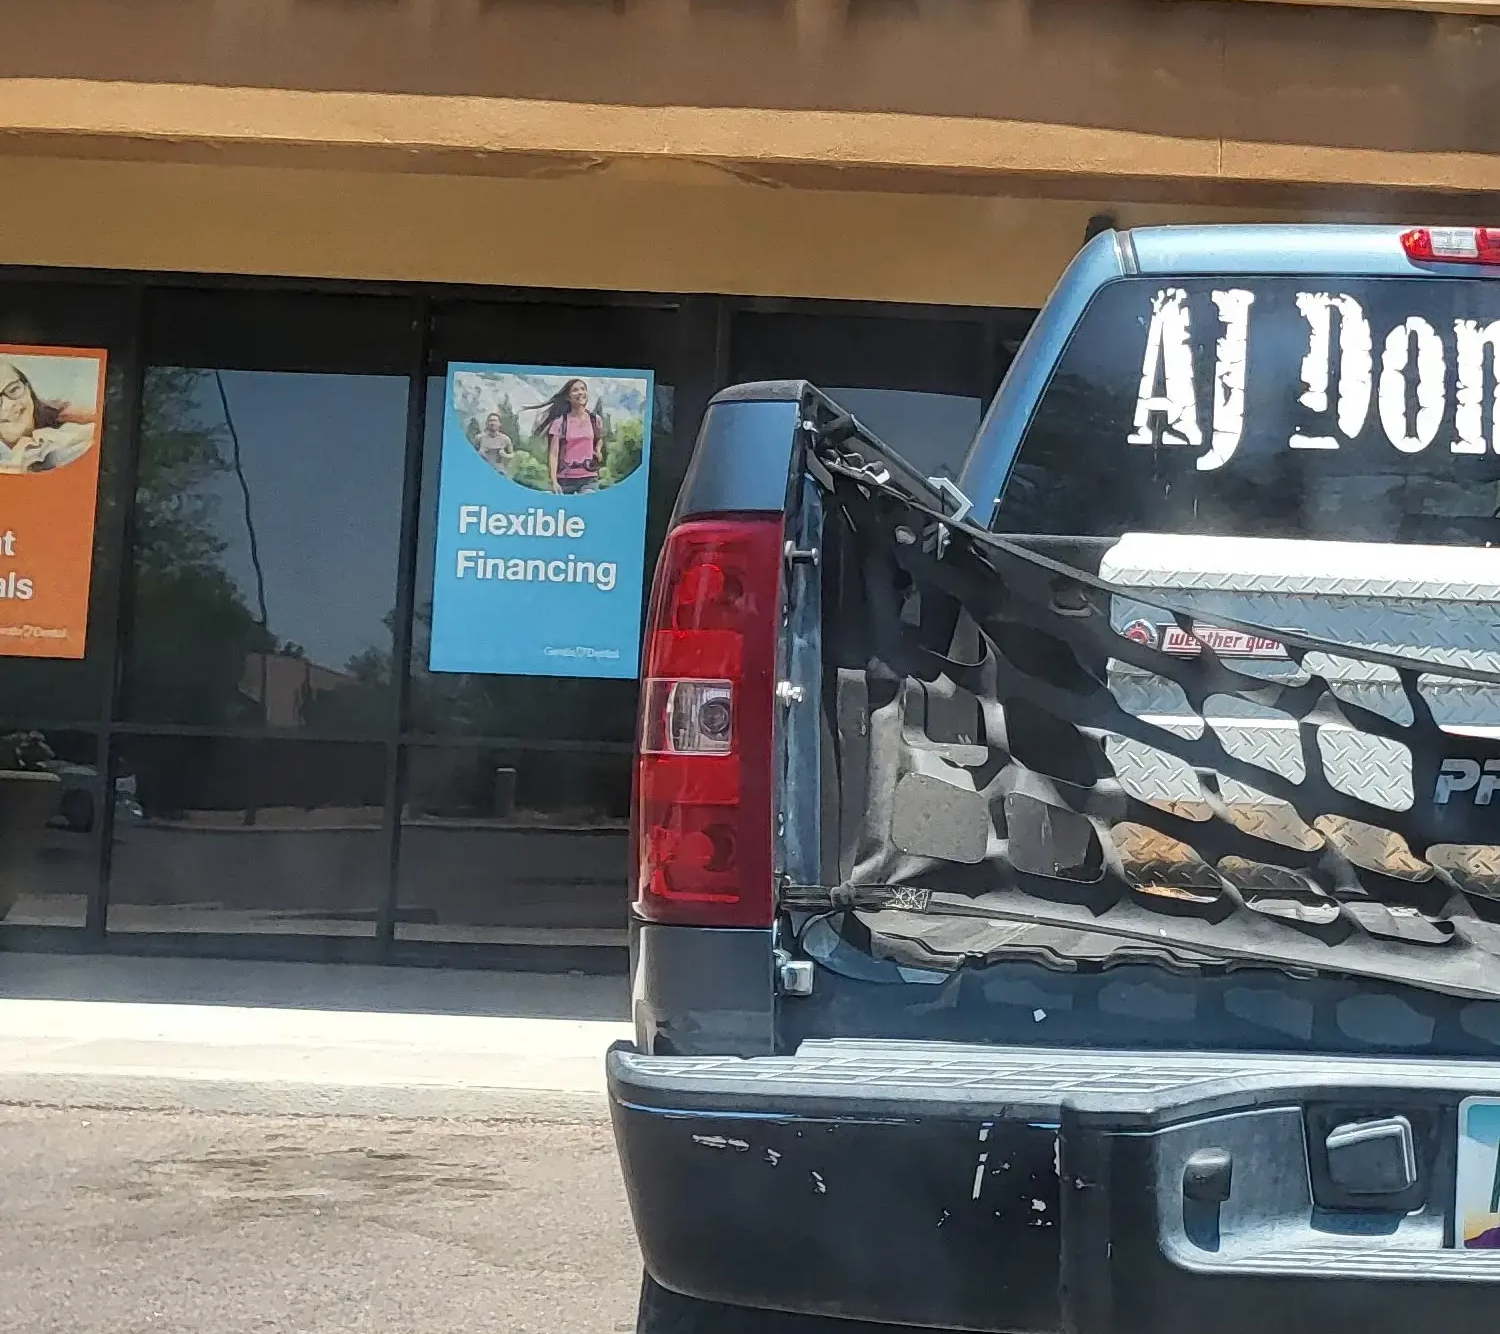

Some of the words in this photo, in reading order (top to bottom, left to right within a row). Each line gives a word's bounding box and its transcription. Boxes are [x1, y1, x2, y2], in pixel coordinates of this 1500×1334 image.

[1127, 287, 1255, 471] AJ
[458, 504, 586, 538] Flexible
[456, 549, 618, 591] Financing
